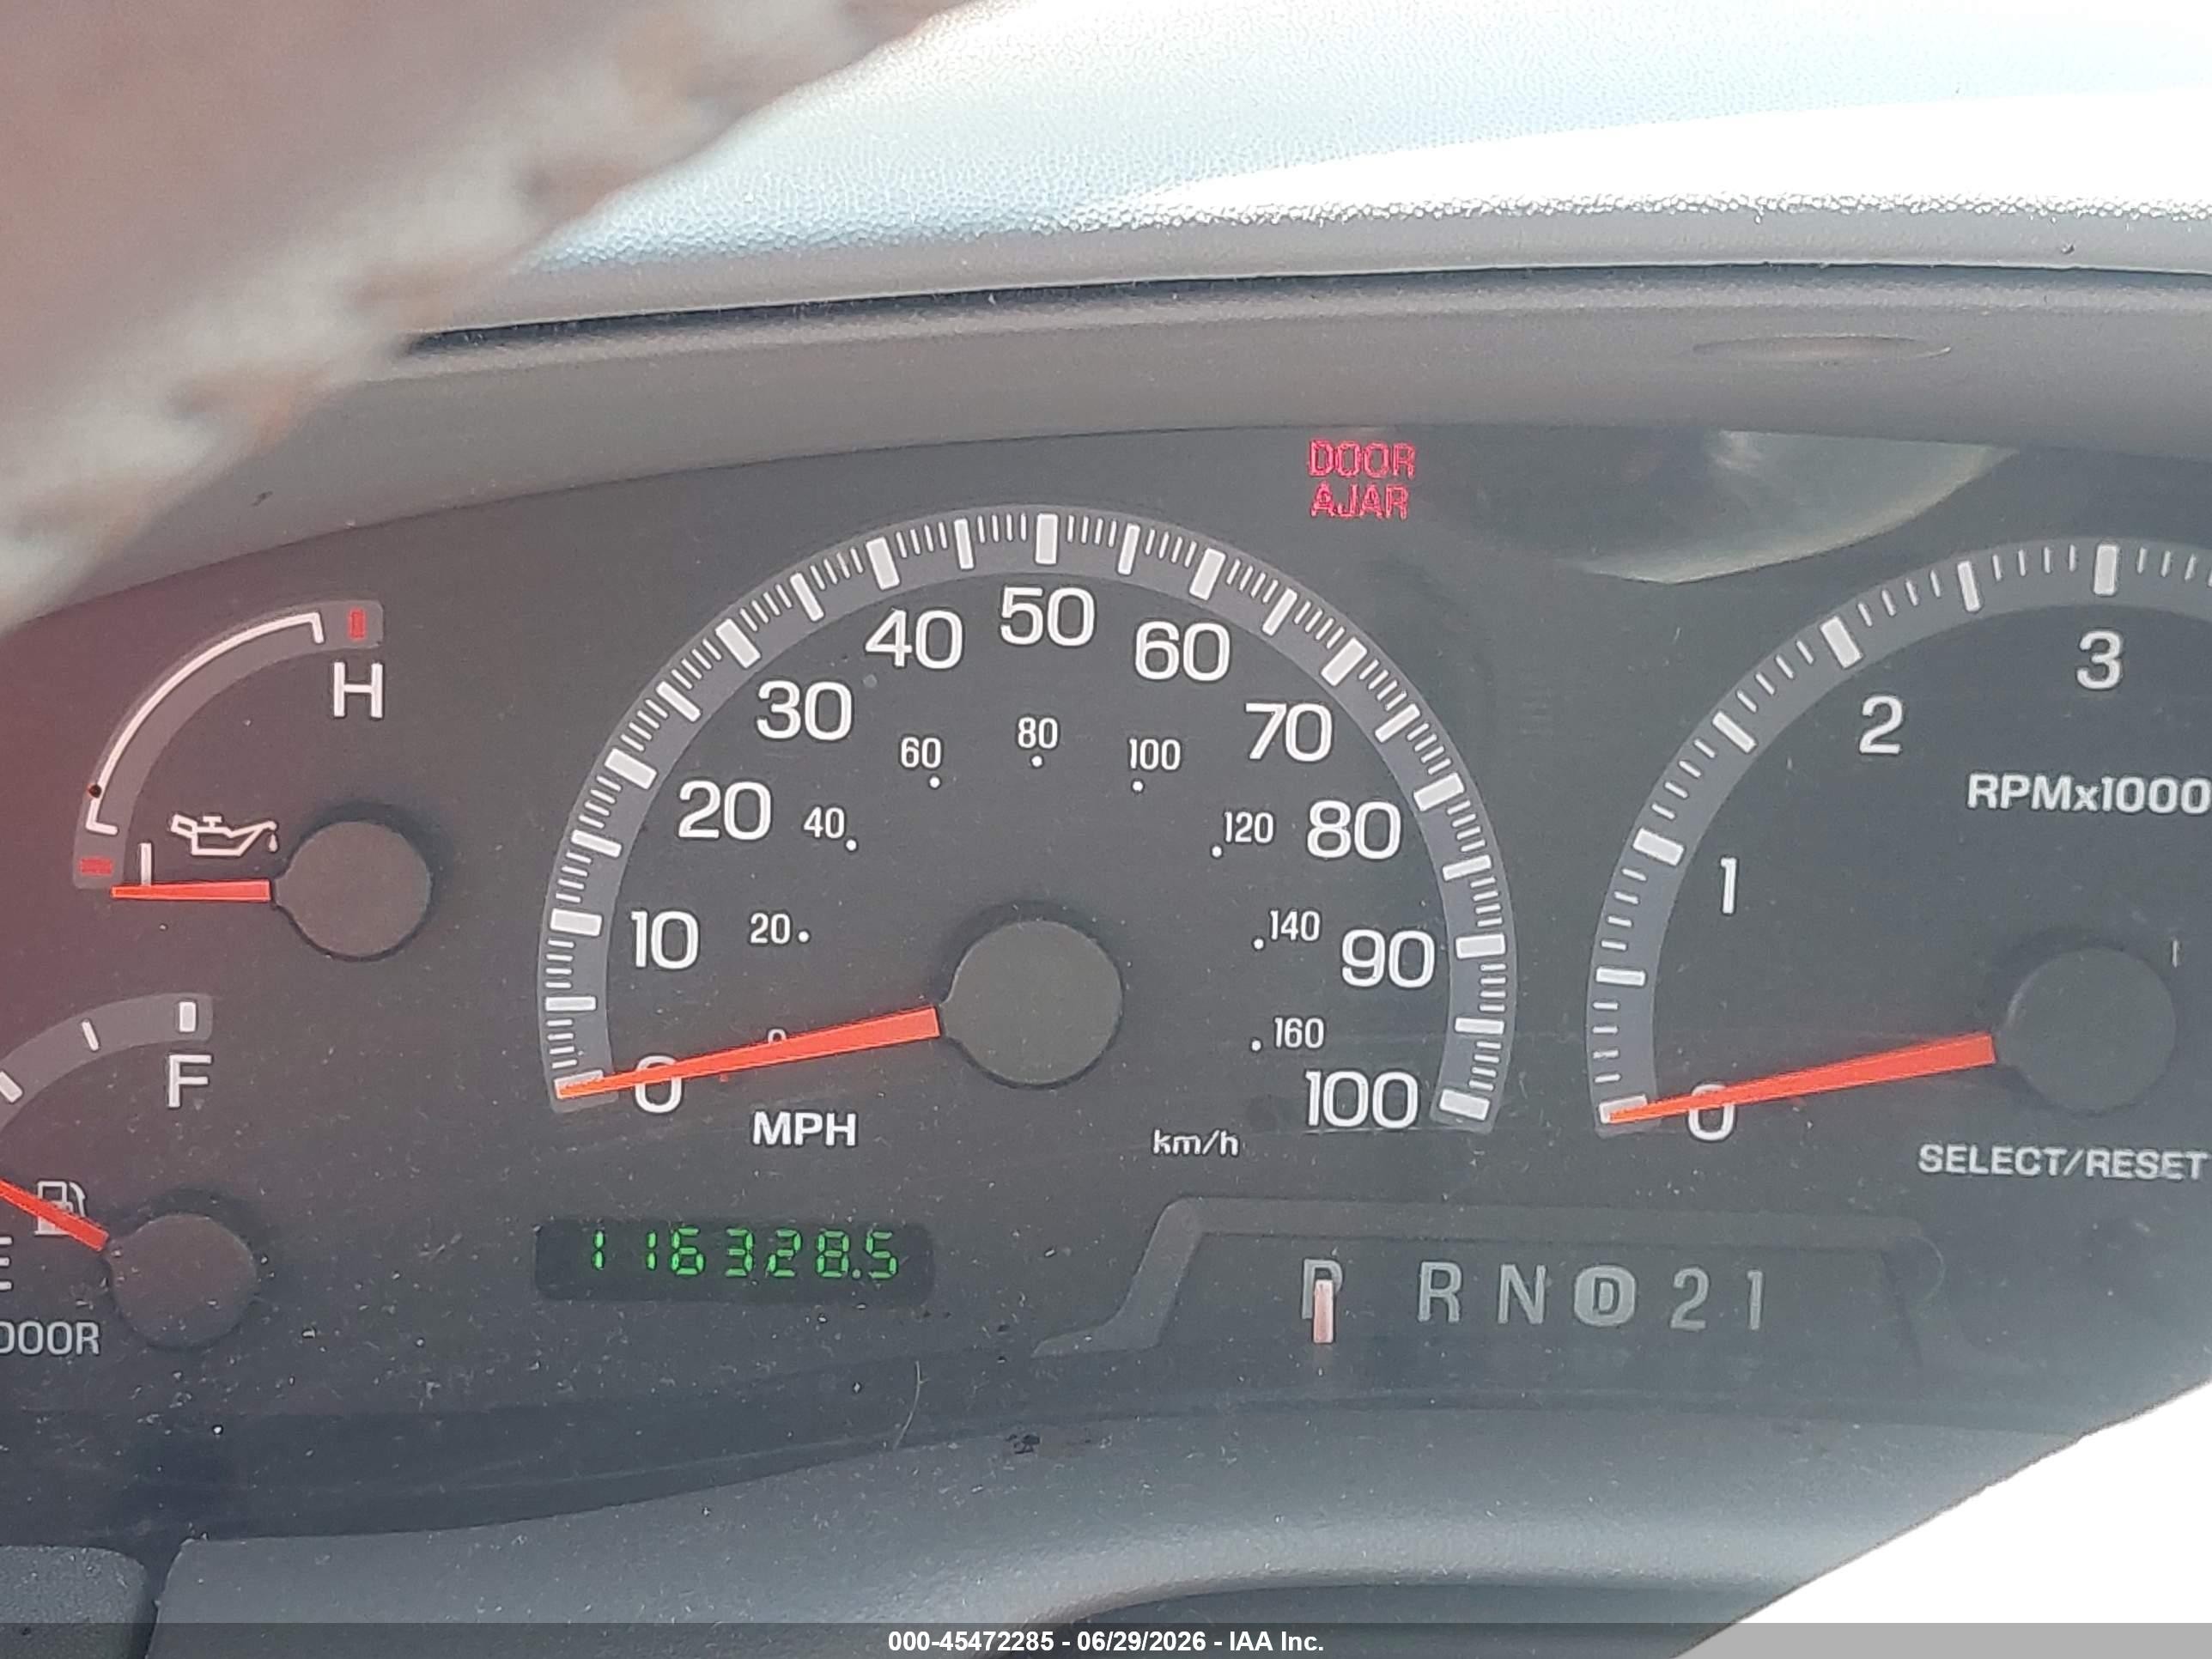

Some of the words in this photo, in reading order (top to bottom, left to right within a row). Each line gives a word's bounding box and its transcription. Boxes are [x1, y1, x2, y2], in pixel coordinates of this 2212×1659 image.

[1310, 441, 1415, 478] DOOR
[1311, 482, 1410, 520] AJAR
[865, 610, 963, 669] 40
[1000, 586, 1095, 647] 50
[1135, 621, 1231, 681] 60
[2077, 630, 2121, 689] 3
[333, 661, 383, 718] H
[757, 680, 852, 740] 30
[901, 737, 941, 769] 60
[1018, 717, 1058, 749] 80
[1245, 702, 1333, 762] 70
[1859, 696, 1903, 754] 2
[1129, 738, 1181, 770] 100
[678, 780, 771, 840] 20
[1967, 774, 2211, 814] RPMx1000
[803, 806, 845, 839] 40
[1224, 811, 1273, 843] 120
[1307, 799, 1401, 860] 80
[1721, 858, 1736, 914] 1
[631, 911, 699, 969] 10
[750, 913, 791, 944] 20
[1270, 910, 1321, 941] 140
[1342, 929, 1435, 988] 90
[1274, 1018, 1324, 1048] 160
[168, 1054, 211, 1108] F
[632, 1053, 684, 1115] 0
[1305, 1071, 1418, 1128] 100
[753, 1111, 856, 1146] MPH
[1686, 1082, 1736, 1142] 0
[1153, 1129, 1238, 1156] km/h
[1918, 1144, 2209, 1180] SELECT/RESET
[592, 1227, 898, 1278] 116328.5
[1418, 1261, 1462, 1322] R
[1498, 1264, 1547, 1324] N
[1670, 1267, 1709, 1329] 2
[1747, 1270, 1763, 1330] 1
